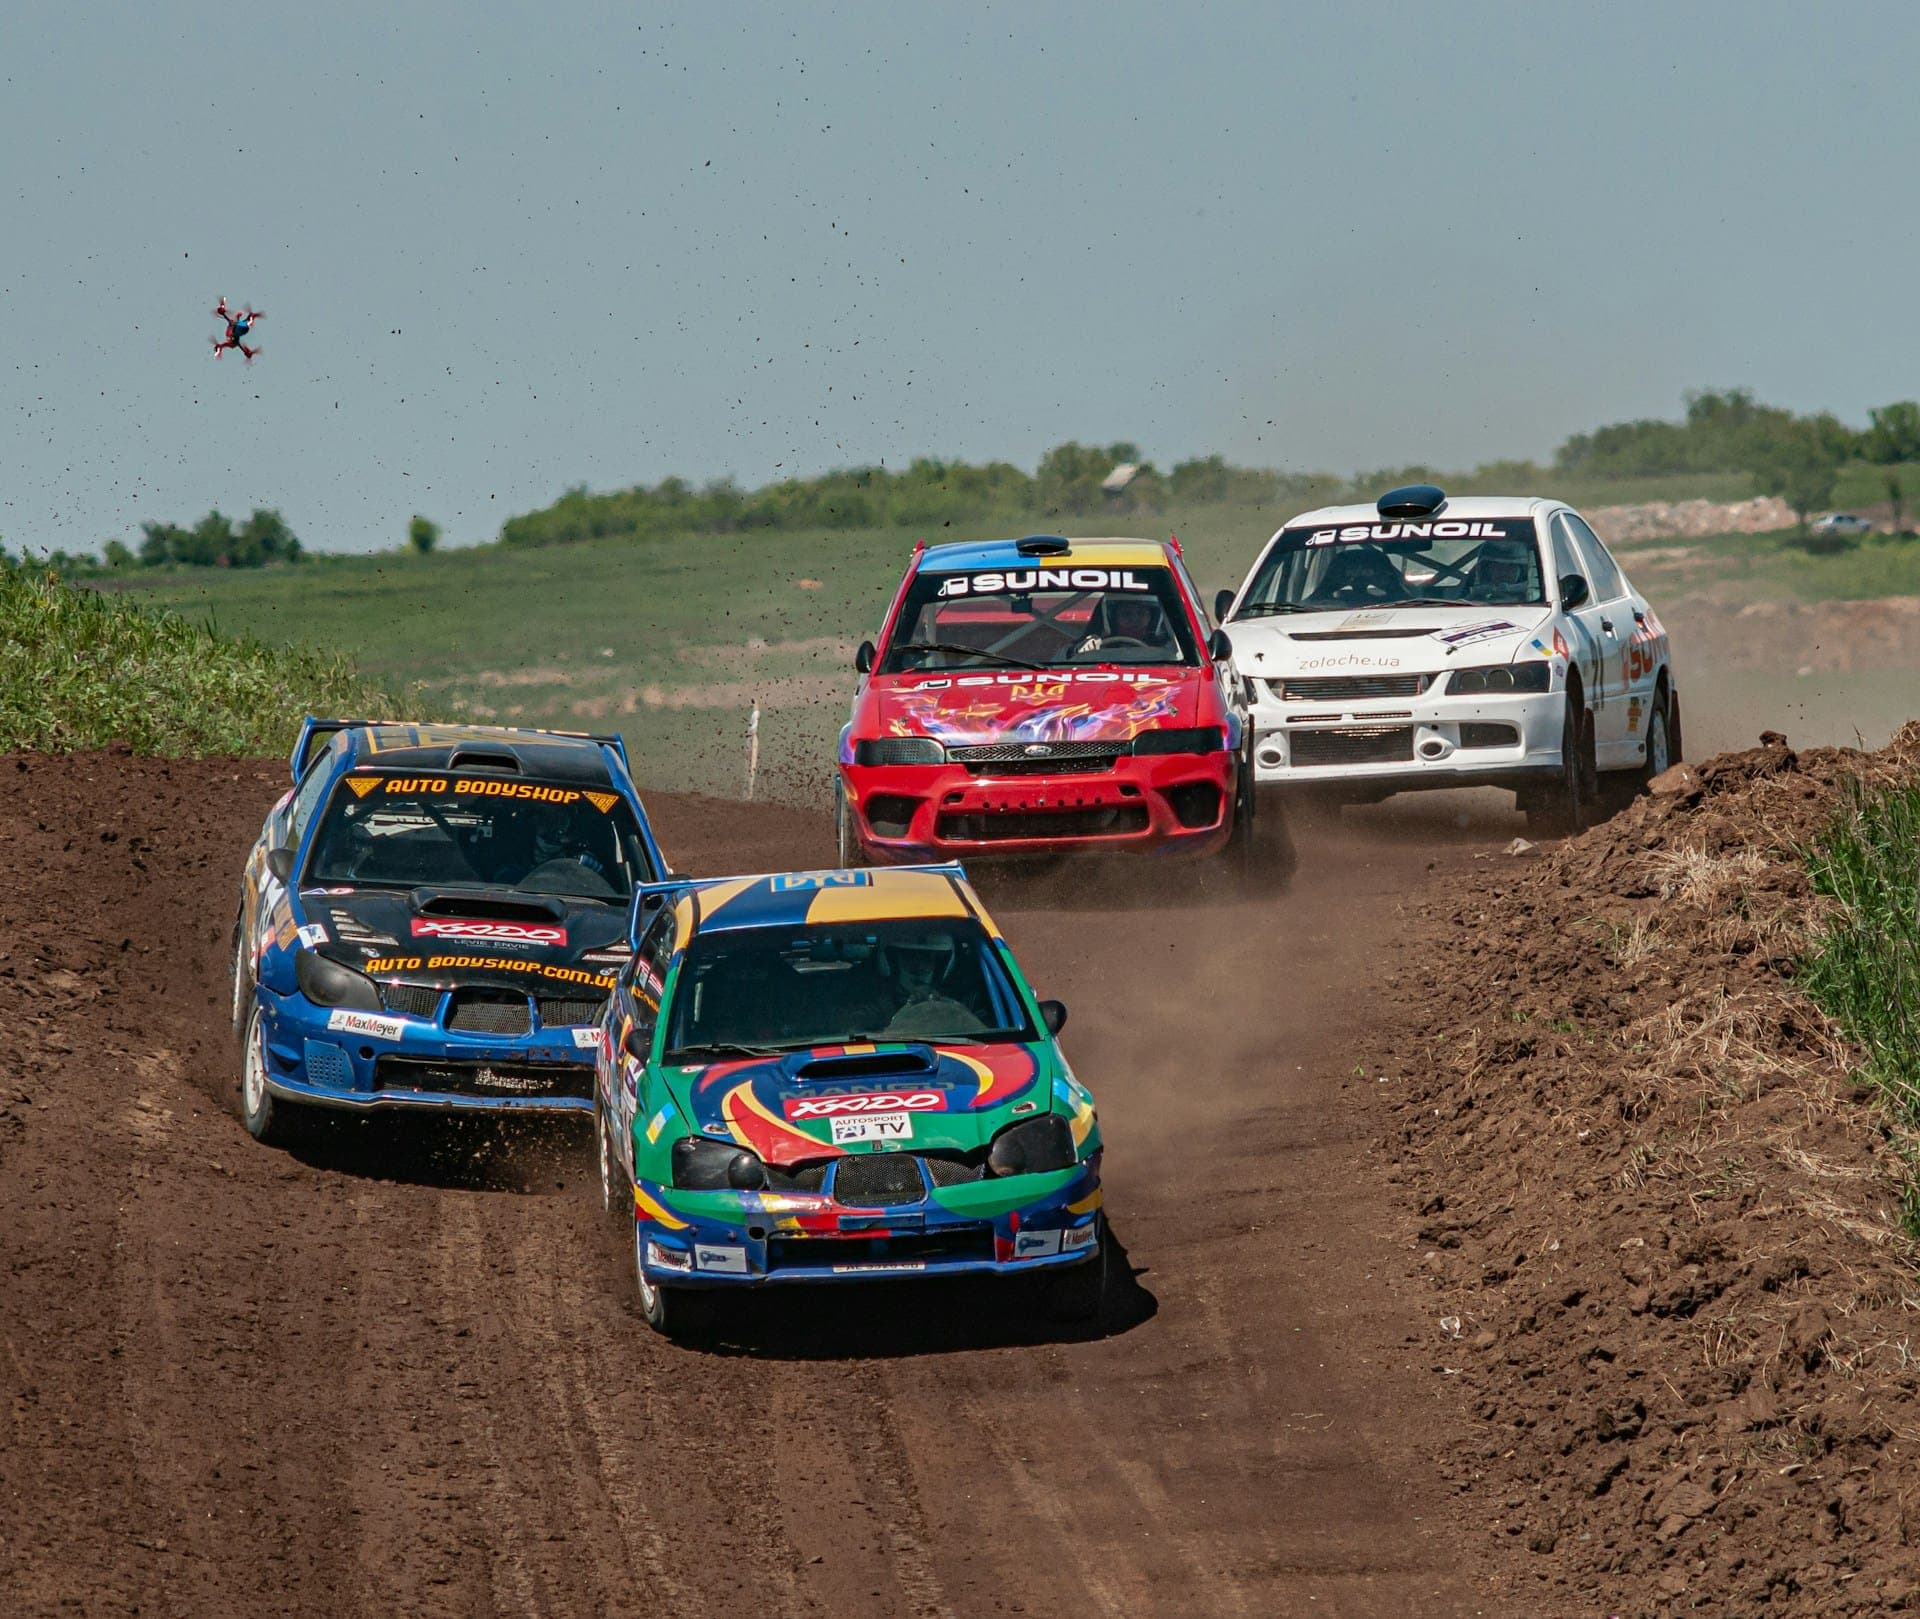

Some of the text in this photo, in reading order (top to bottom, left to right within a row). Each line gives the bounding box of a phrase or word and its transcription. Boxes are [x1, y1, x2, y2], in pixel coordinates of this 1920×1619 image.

[1339, 522, 1507, 542] SUNOIL
[972, 570, 1149, 591] SUNOIL
[1298, 653, 1401, 670] zoloche.ua
[957, 672, 1168, 686] SUNOIL
[385, 779, 448, 793] AUTO
[454, 780, 580, 804] BODYSHOP
[417, 922, 561, 940] XADO
[366, 957, 422, 973] AUTO
[345, 1015, 398, 1036] MaxMeyer
[791, 1094, 940, 1117] XADO
[835, 1115, 904, 1126] AUTOSPORT
[875, 1122, 905, 1135] TV
